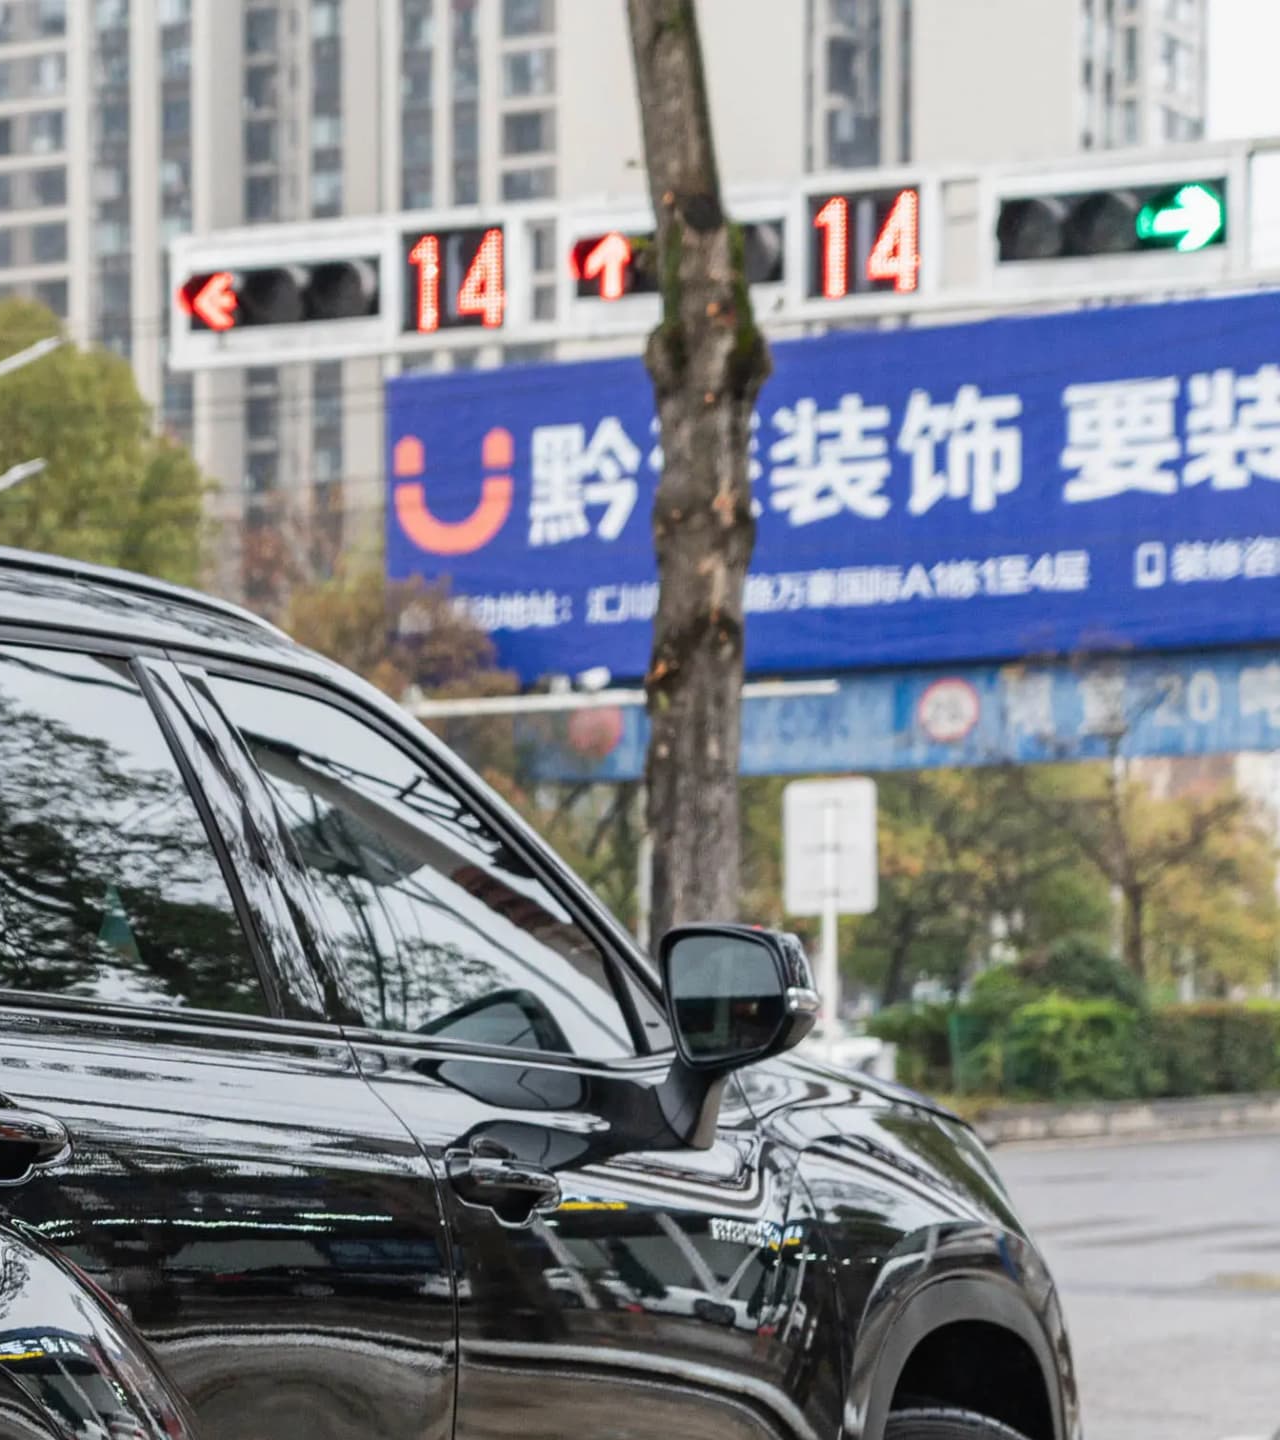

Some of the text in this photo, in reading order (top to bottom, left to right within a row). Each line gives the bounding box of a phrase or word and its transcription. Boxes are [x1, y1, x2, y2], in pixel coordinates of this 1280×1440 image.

[408, 229, 505, 332] 14
[814, 188, 922, 298] 14
[528, 363, 1280, 546] 黔装饰 要装
